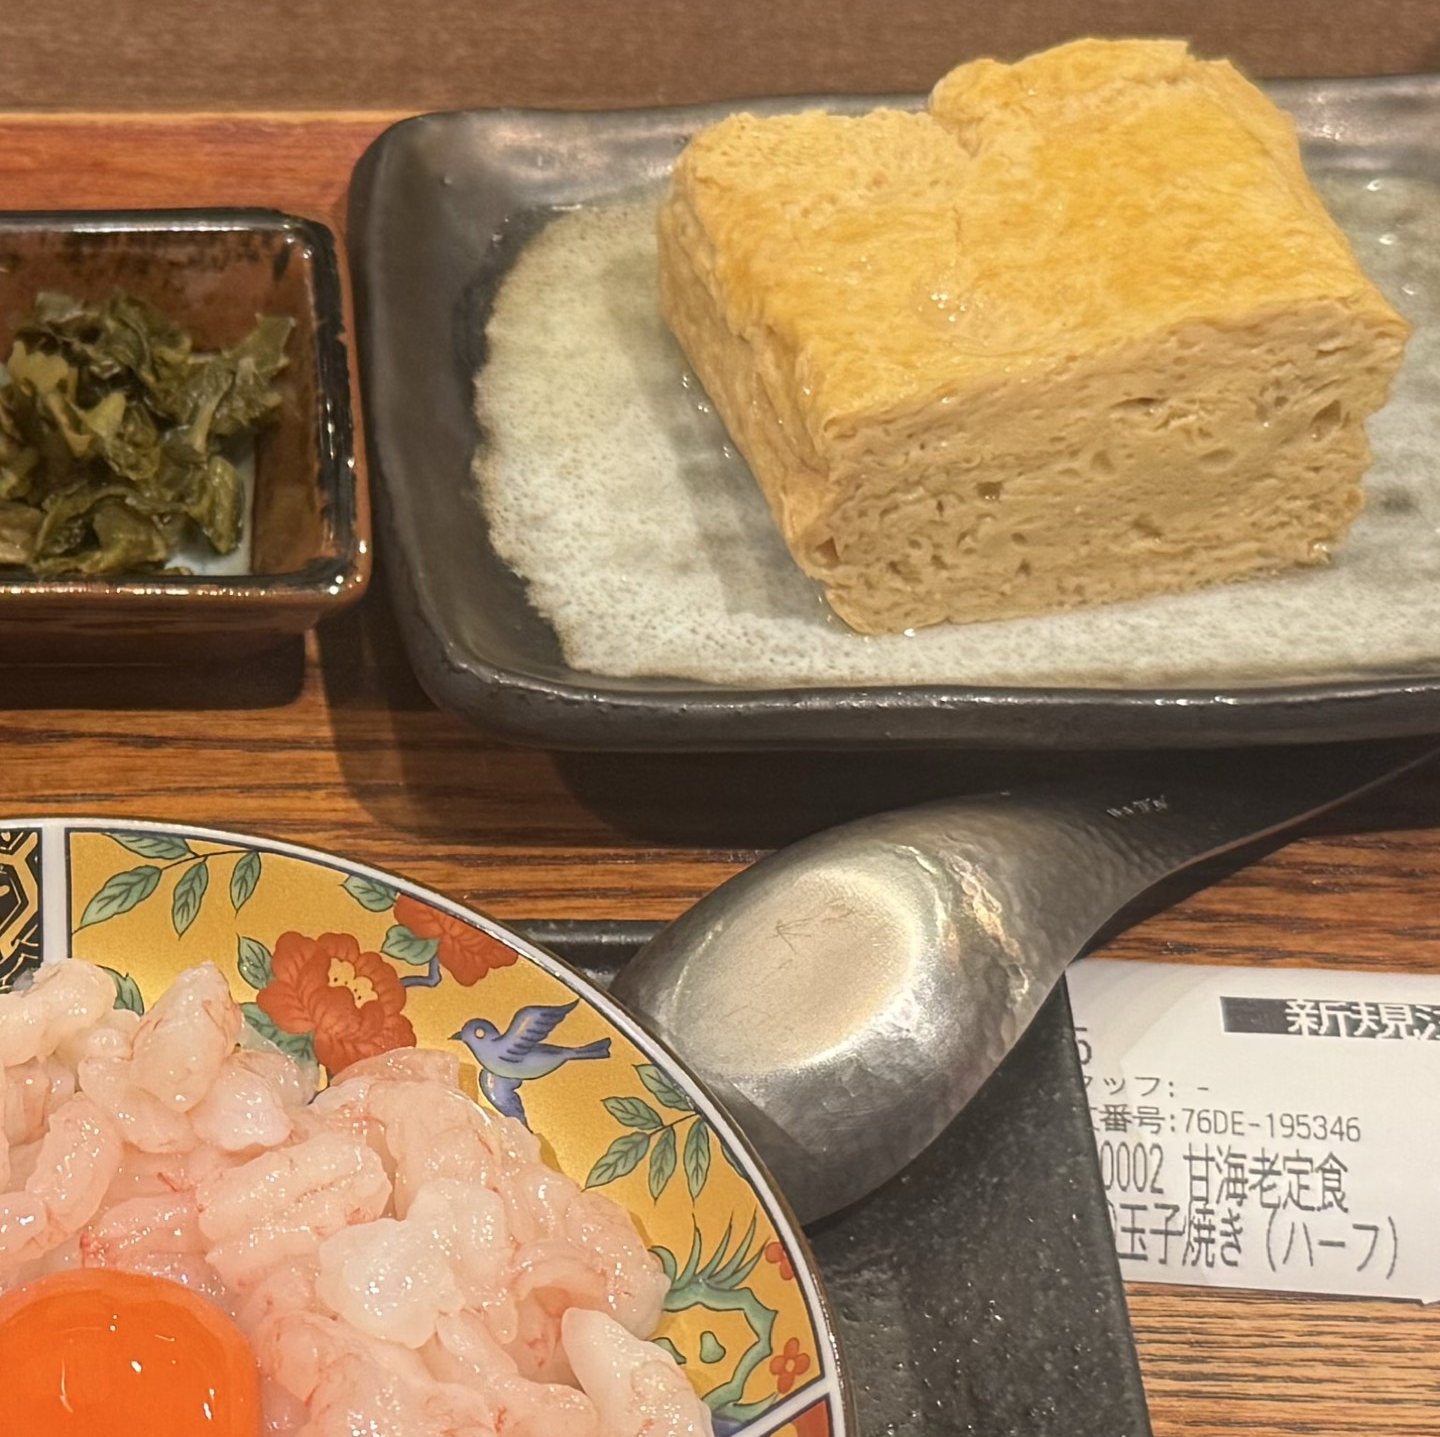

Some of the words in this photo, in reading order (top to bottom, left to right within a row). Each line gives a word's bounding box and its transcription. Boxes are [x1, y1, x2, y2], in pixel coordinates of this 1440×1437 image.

[1182, 1141, 1350, 1214] 甘海老定食
[1106, 1198, 1398, 1280] 玉子焼き(ハーフ)
